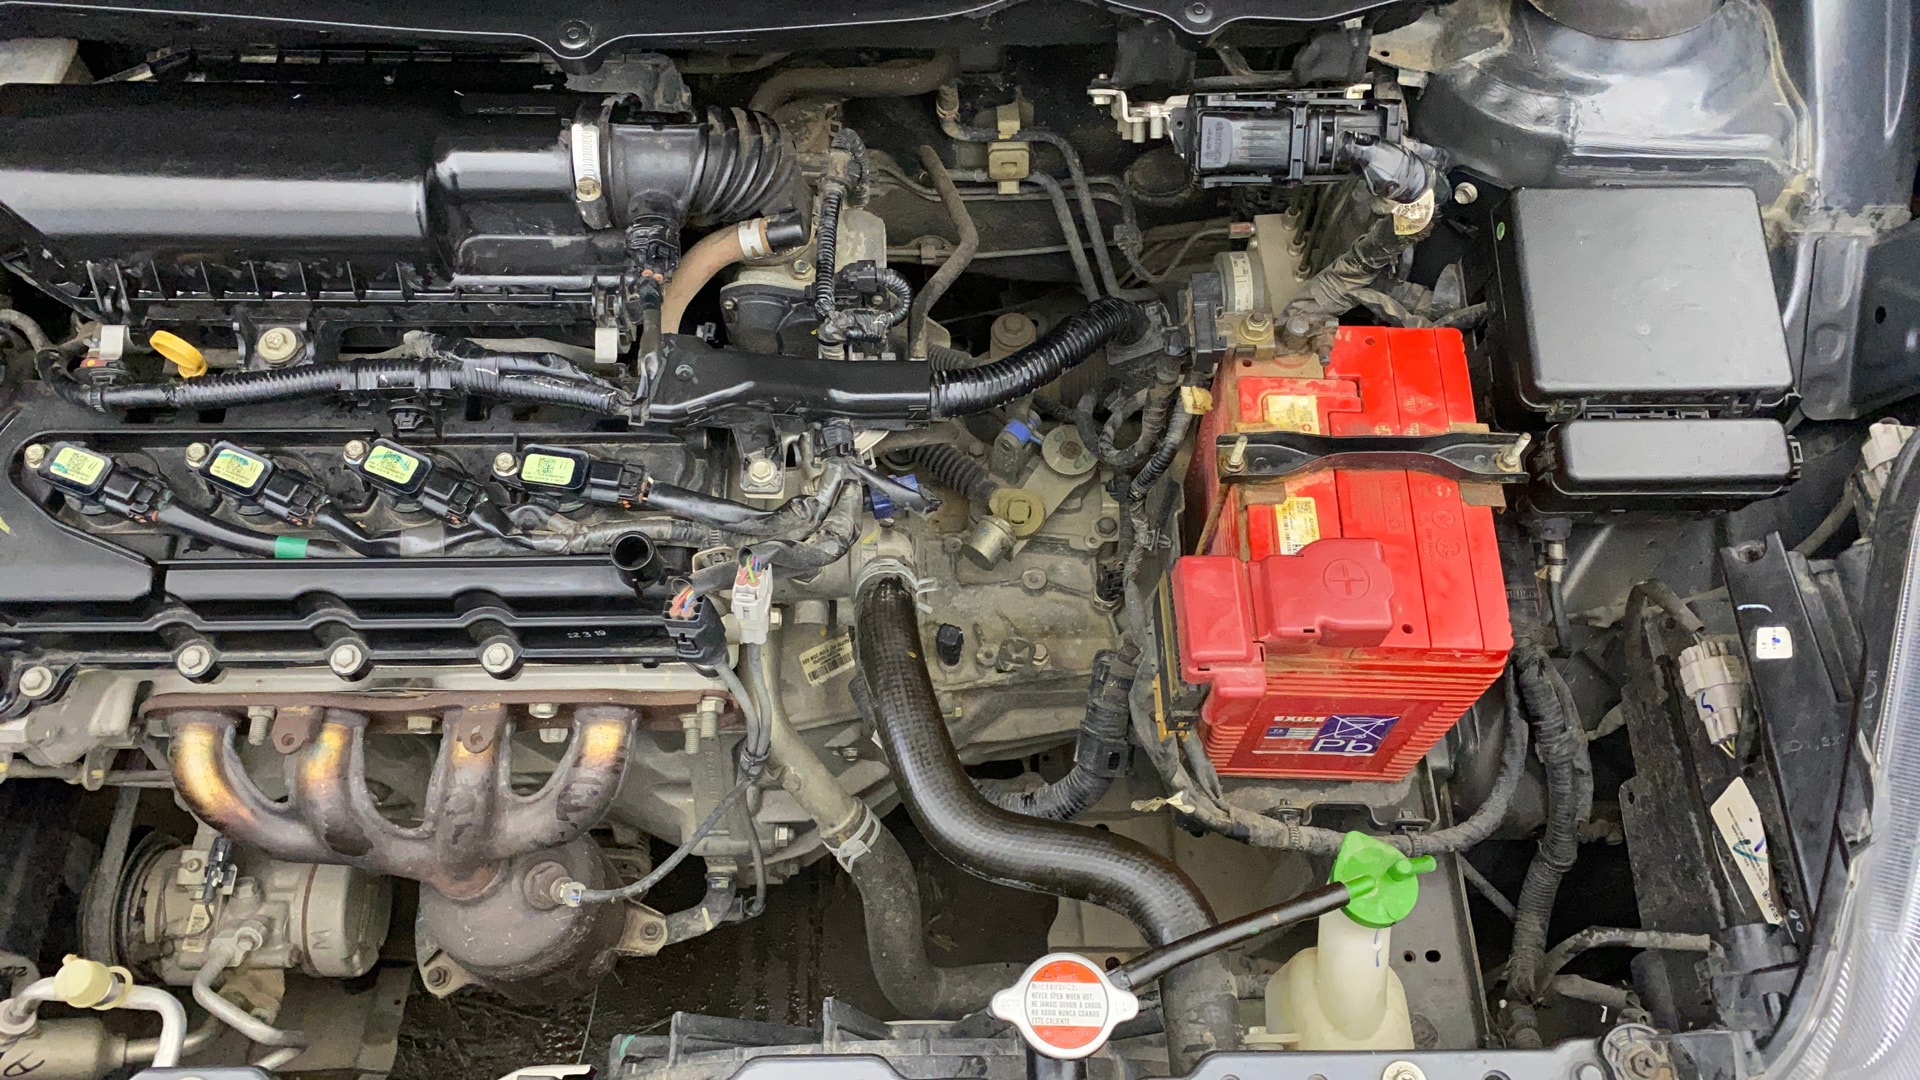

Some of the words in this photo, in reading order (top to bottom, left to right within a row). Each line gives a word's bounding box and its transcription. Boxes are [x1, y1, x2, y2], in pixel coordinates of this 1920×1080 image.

[1273, 715, 1327, 723] EXIDE
[1313, 738, 1373, 753] Pb
[1031, 992, 1048, 1000] NEVER
[1050, 992, 1063, 1000] OPEN
